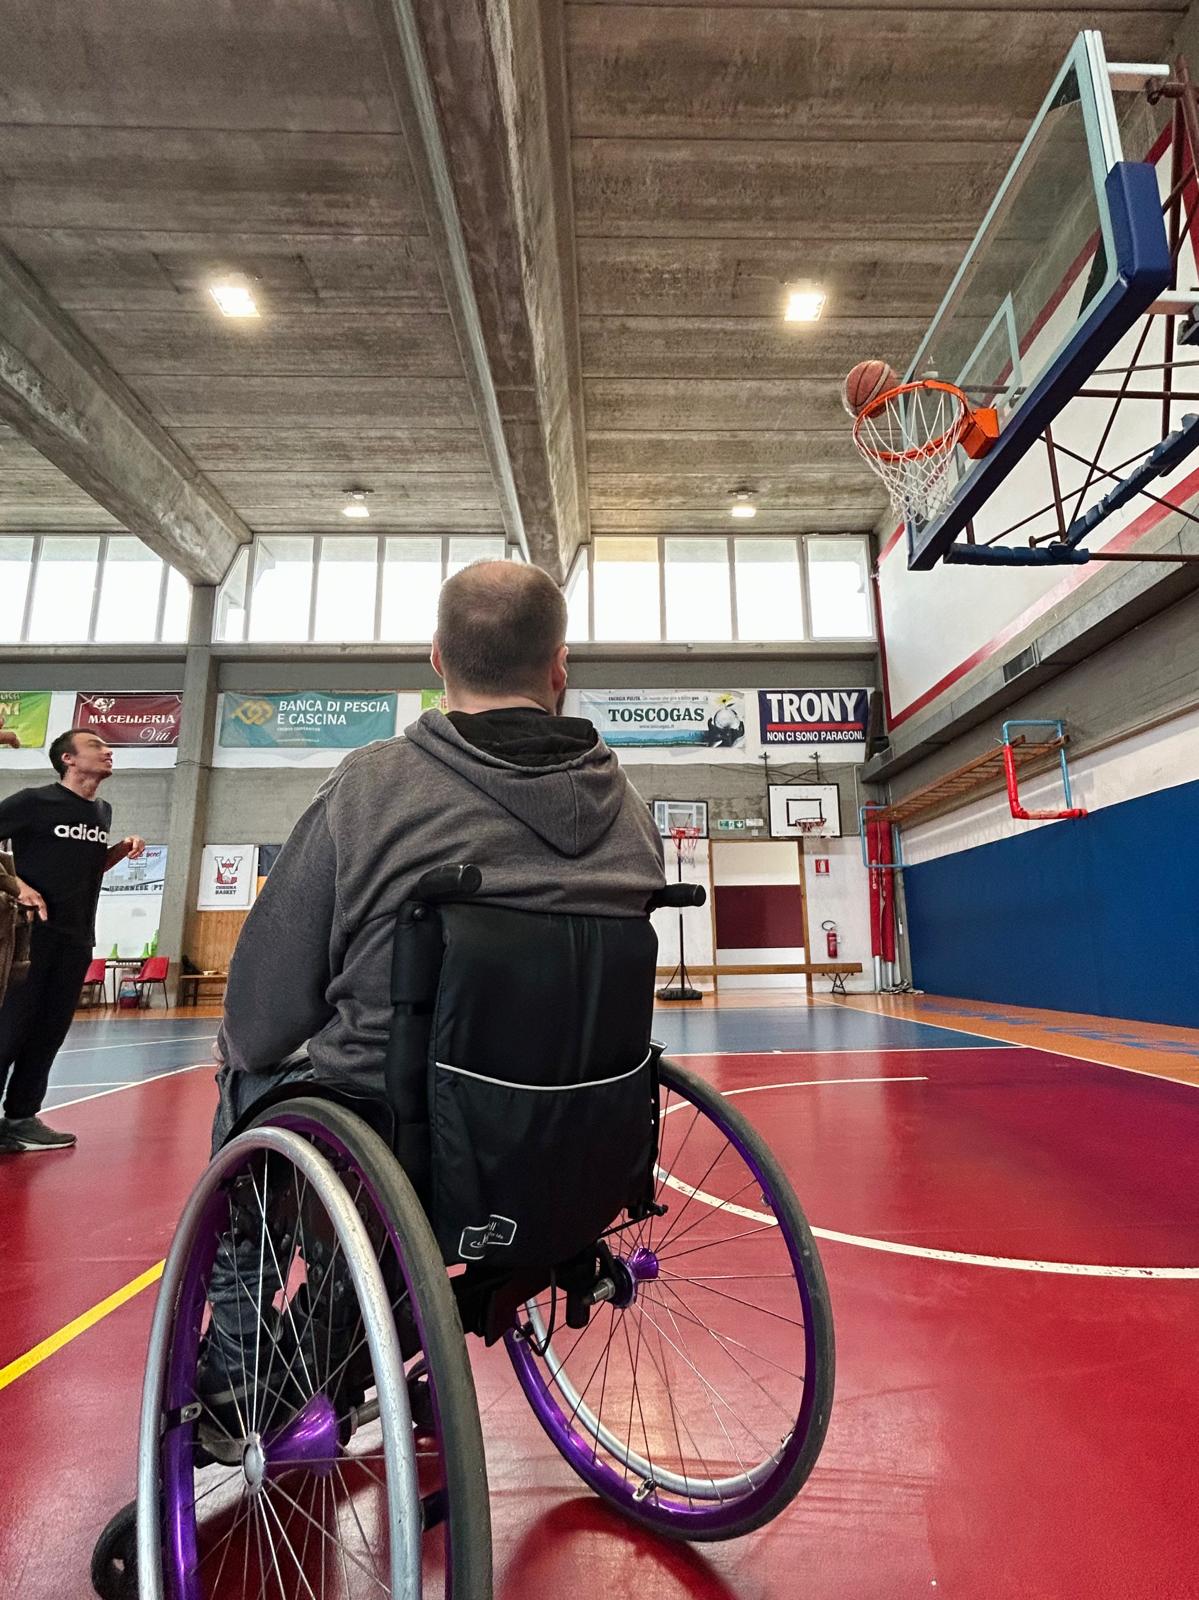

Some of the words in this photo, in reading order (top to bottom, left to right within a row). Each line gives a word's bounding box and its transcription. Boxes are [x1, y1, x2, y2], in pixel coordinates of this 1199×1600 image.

[279, 700, 322, 712] BANCA
[327, 701, 340, 712] DI
[344, 701, 390, 713] PESCIA
[766, 692, 859, 722] TRONY
[88, 714, 176, 724] MACELLERIA
[277, 713, 285, 725] E
[288, 713, 347, 725] CASCINA
[608, 708, 705, 722] TOSCOGAS
[767, 731, 785, 741] NON
[786, 732, 795, 740] CI
[795, 731, 819, 741] SONO
[820, 730, 865, 741] PARAGONI.
[54, 823, 107, 844] adida
